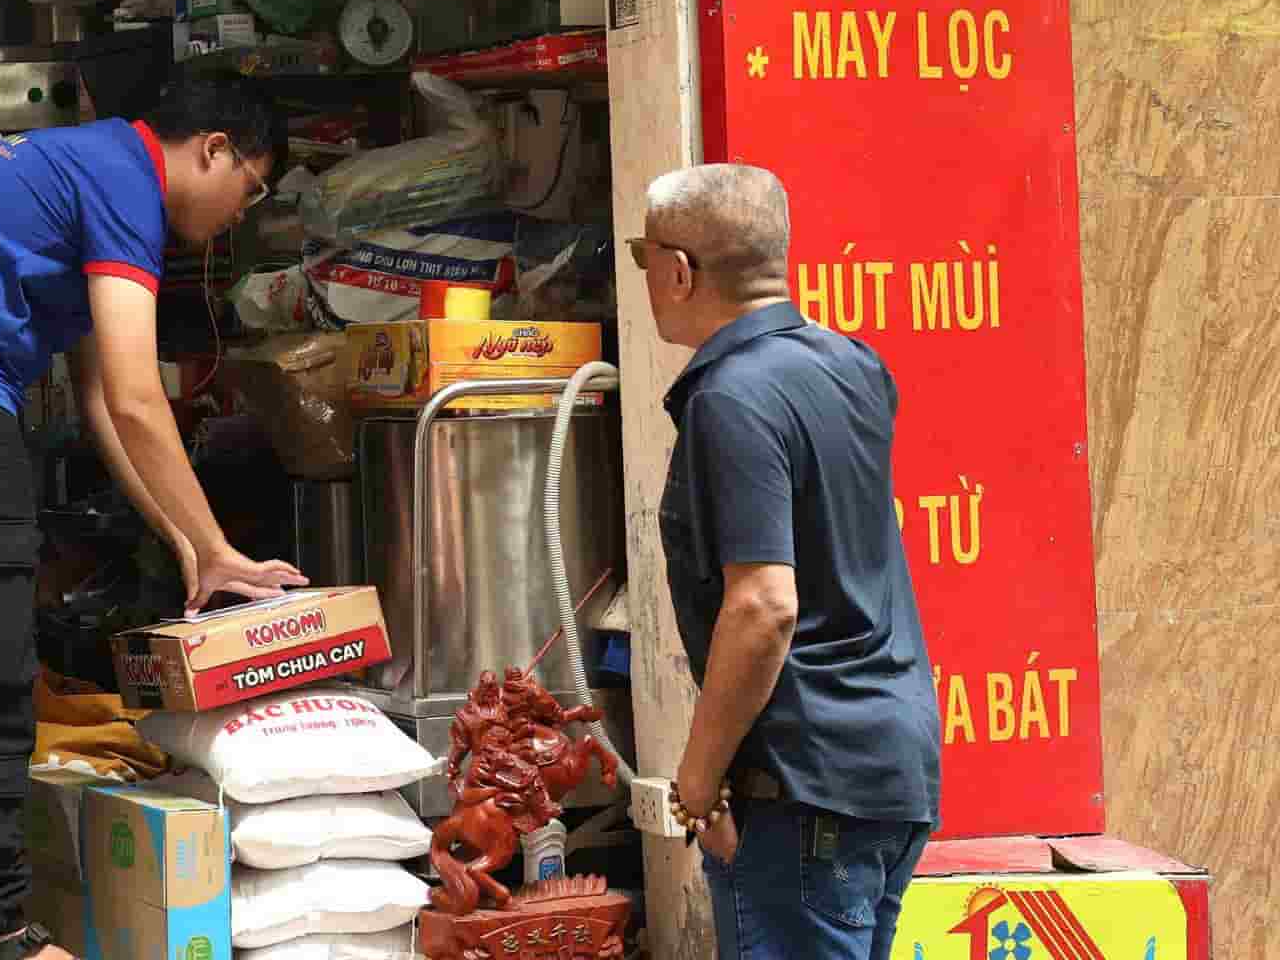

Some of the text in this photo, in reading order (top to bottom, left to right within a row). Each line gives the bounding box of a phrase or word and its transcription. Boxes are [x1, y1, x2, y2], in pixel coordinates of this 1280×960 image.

[917, 9, 1013, 92] LỌC
[798, 240, 1001, 332] HÚT MÙI
[919, 473, 984, 564] TỪ
[233, 640, 365, 690] TÔM CHUA CAY
[245, 607, 327, 648] KOKOMI
[986, 651, 1078, 742] BÁT
